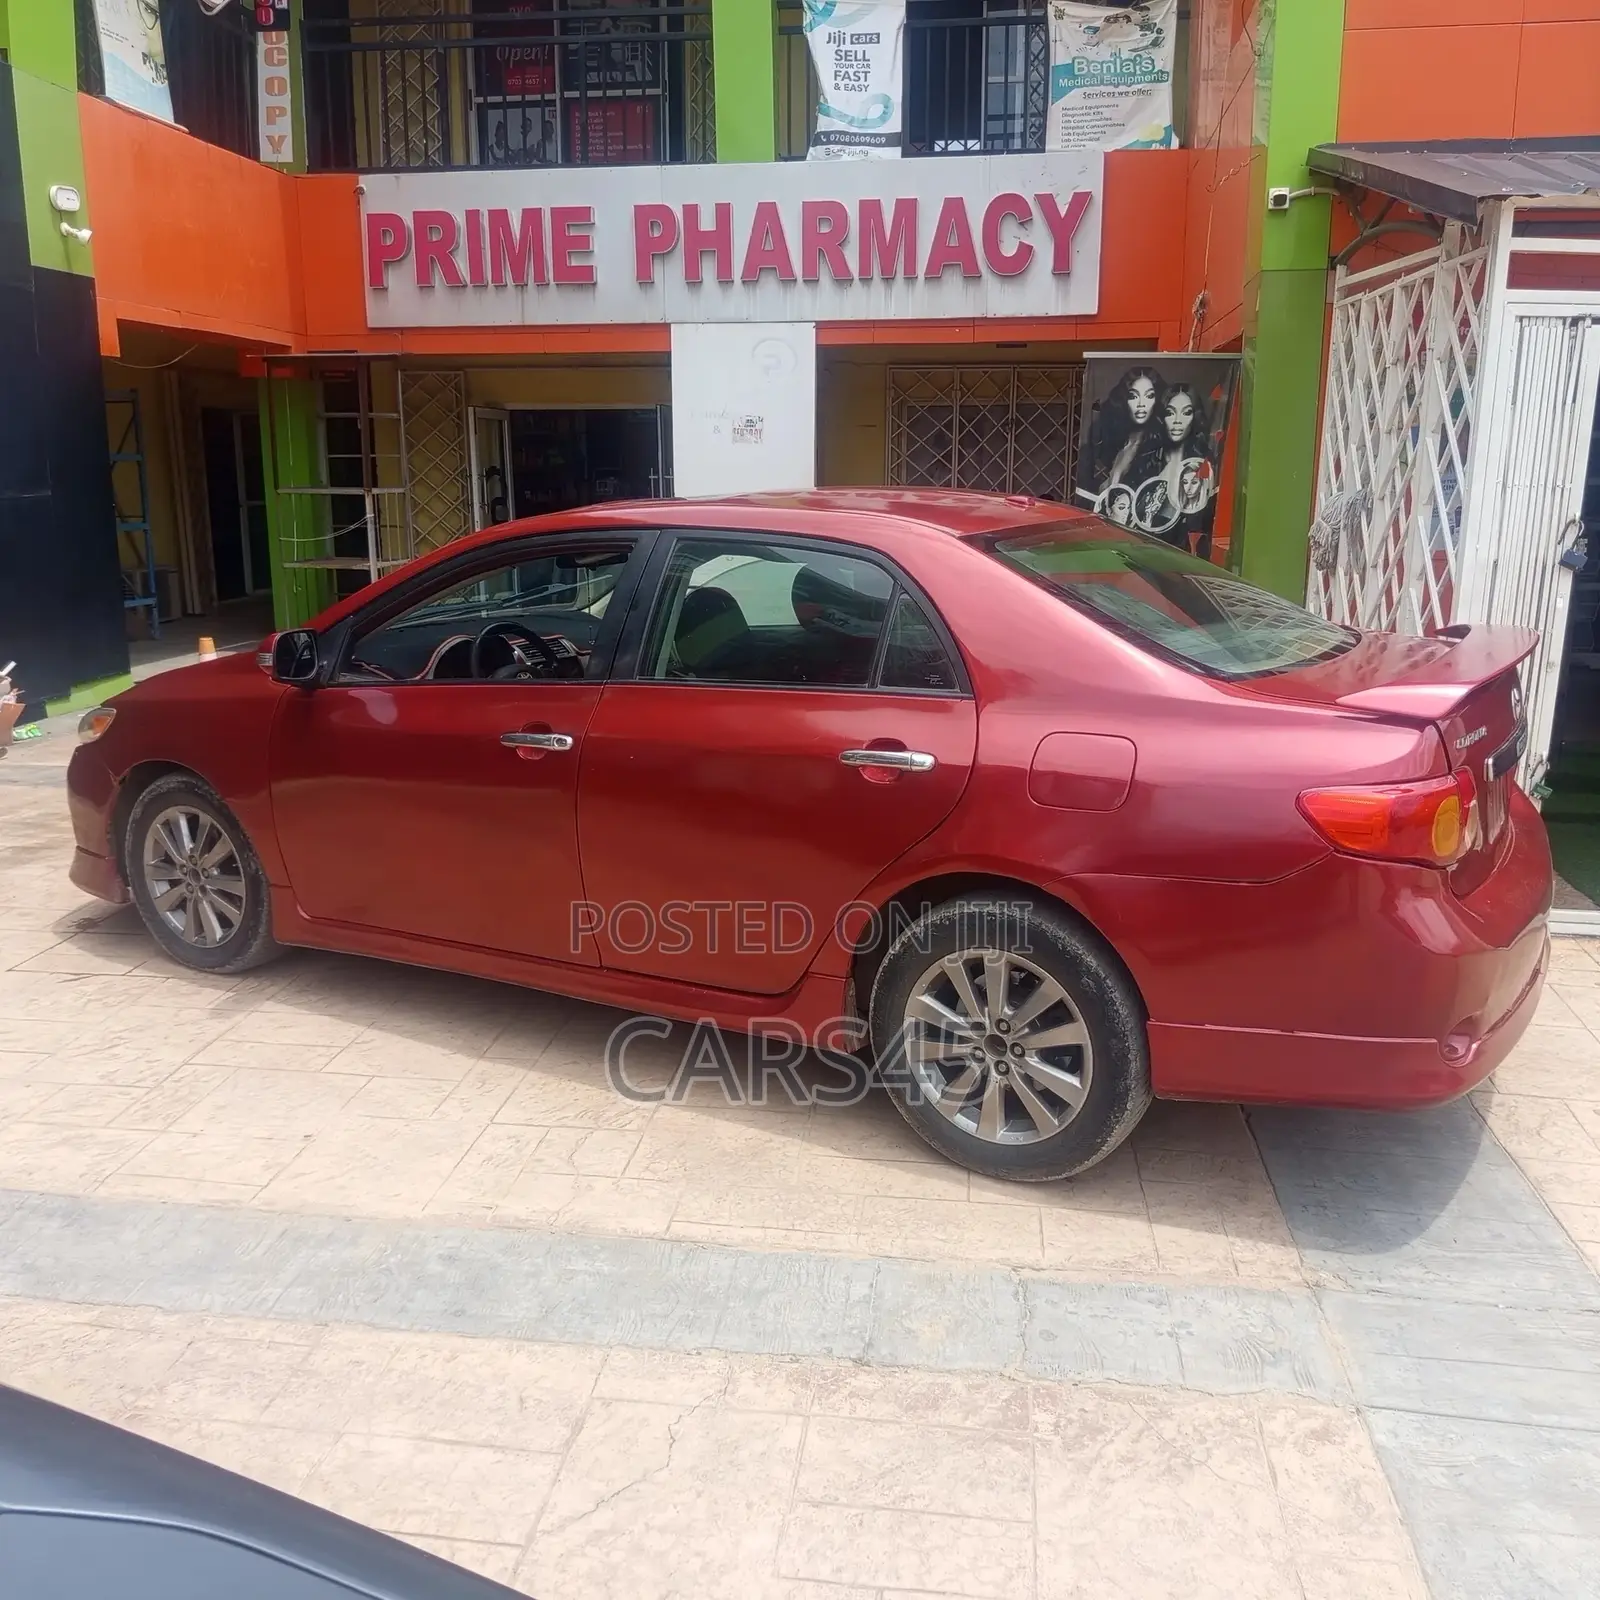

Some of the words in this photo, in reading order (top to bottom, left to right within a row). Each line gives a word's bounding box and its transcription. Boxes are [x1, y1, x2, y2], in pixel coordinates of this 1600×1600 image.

[826, 30, 846, 48] Jiji
[852, 33, 879, 43] cars
[834, 49, 870, 62] SELL
[834, 70, 871, 82] FAST
[1059, 76, 1100, 88] Medical
[1103, 72, 1168, 85] Equipments
[834, 83, 841, 91] &
[844, 84, 869, 92] EASY
[1083, 90, 1115, 99] Services
[1132, 88, 1152, 97] offer:
[1086, 122, 1125, 130] Consumables
[366, 206, 596, 289] PRIME
[634, 191, 1093, 284] PHARMACY
